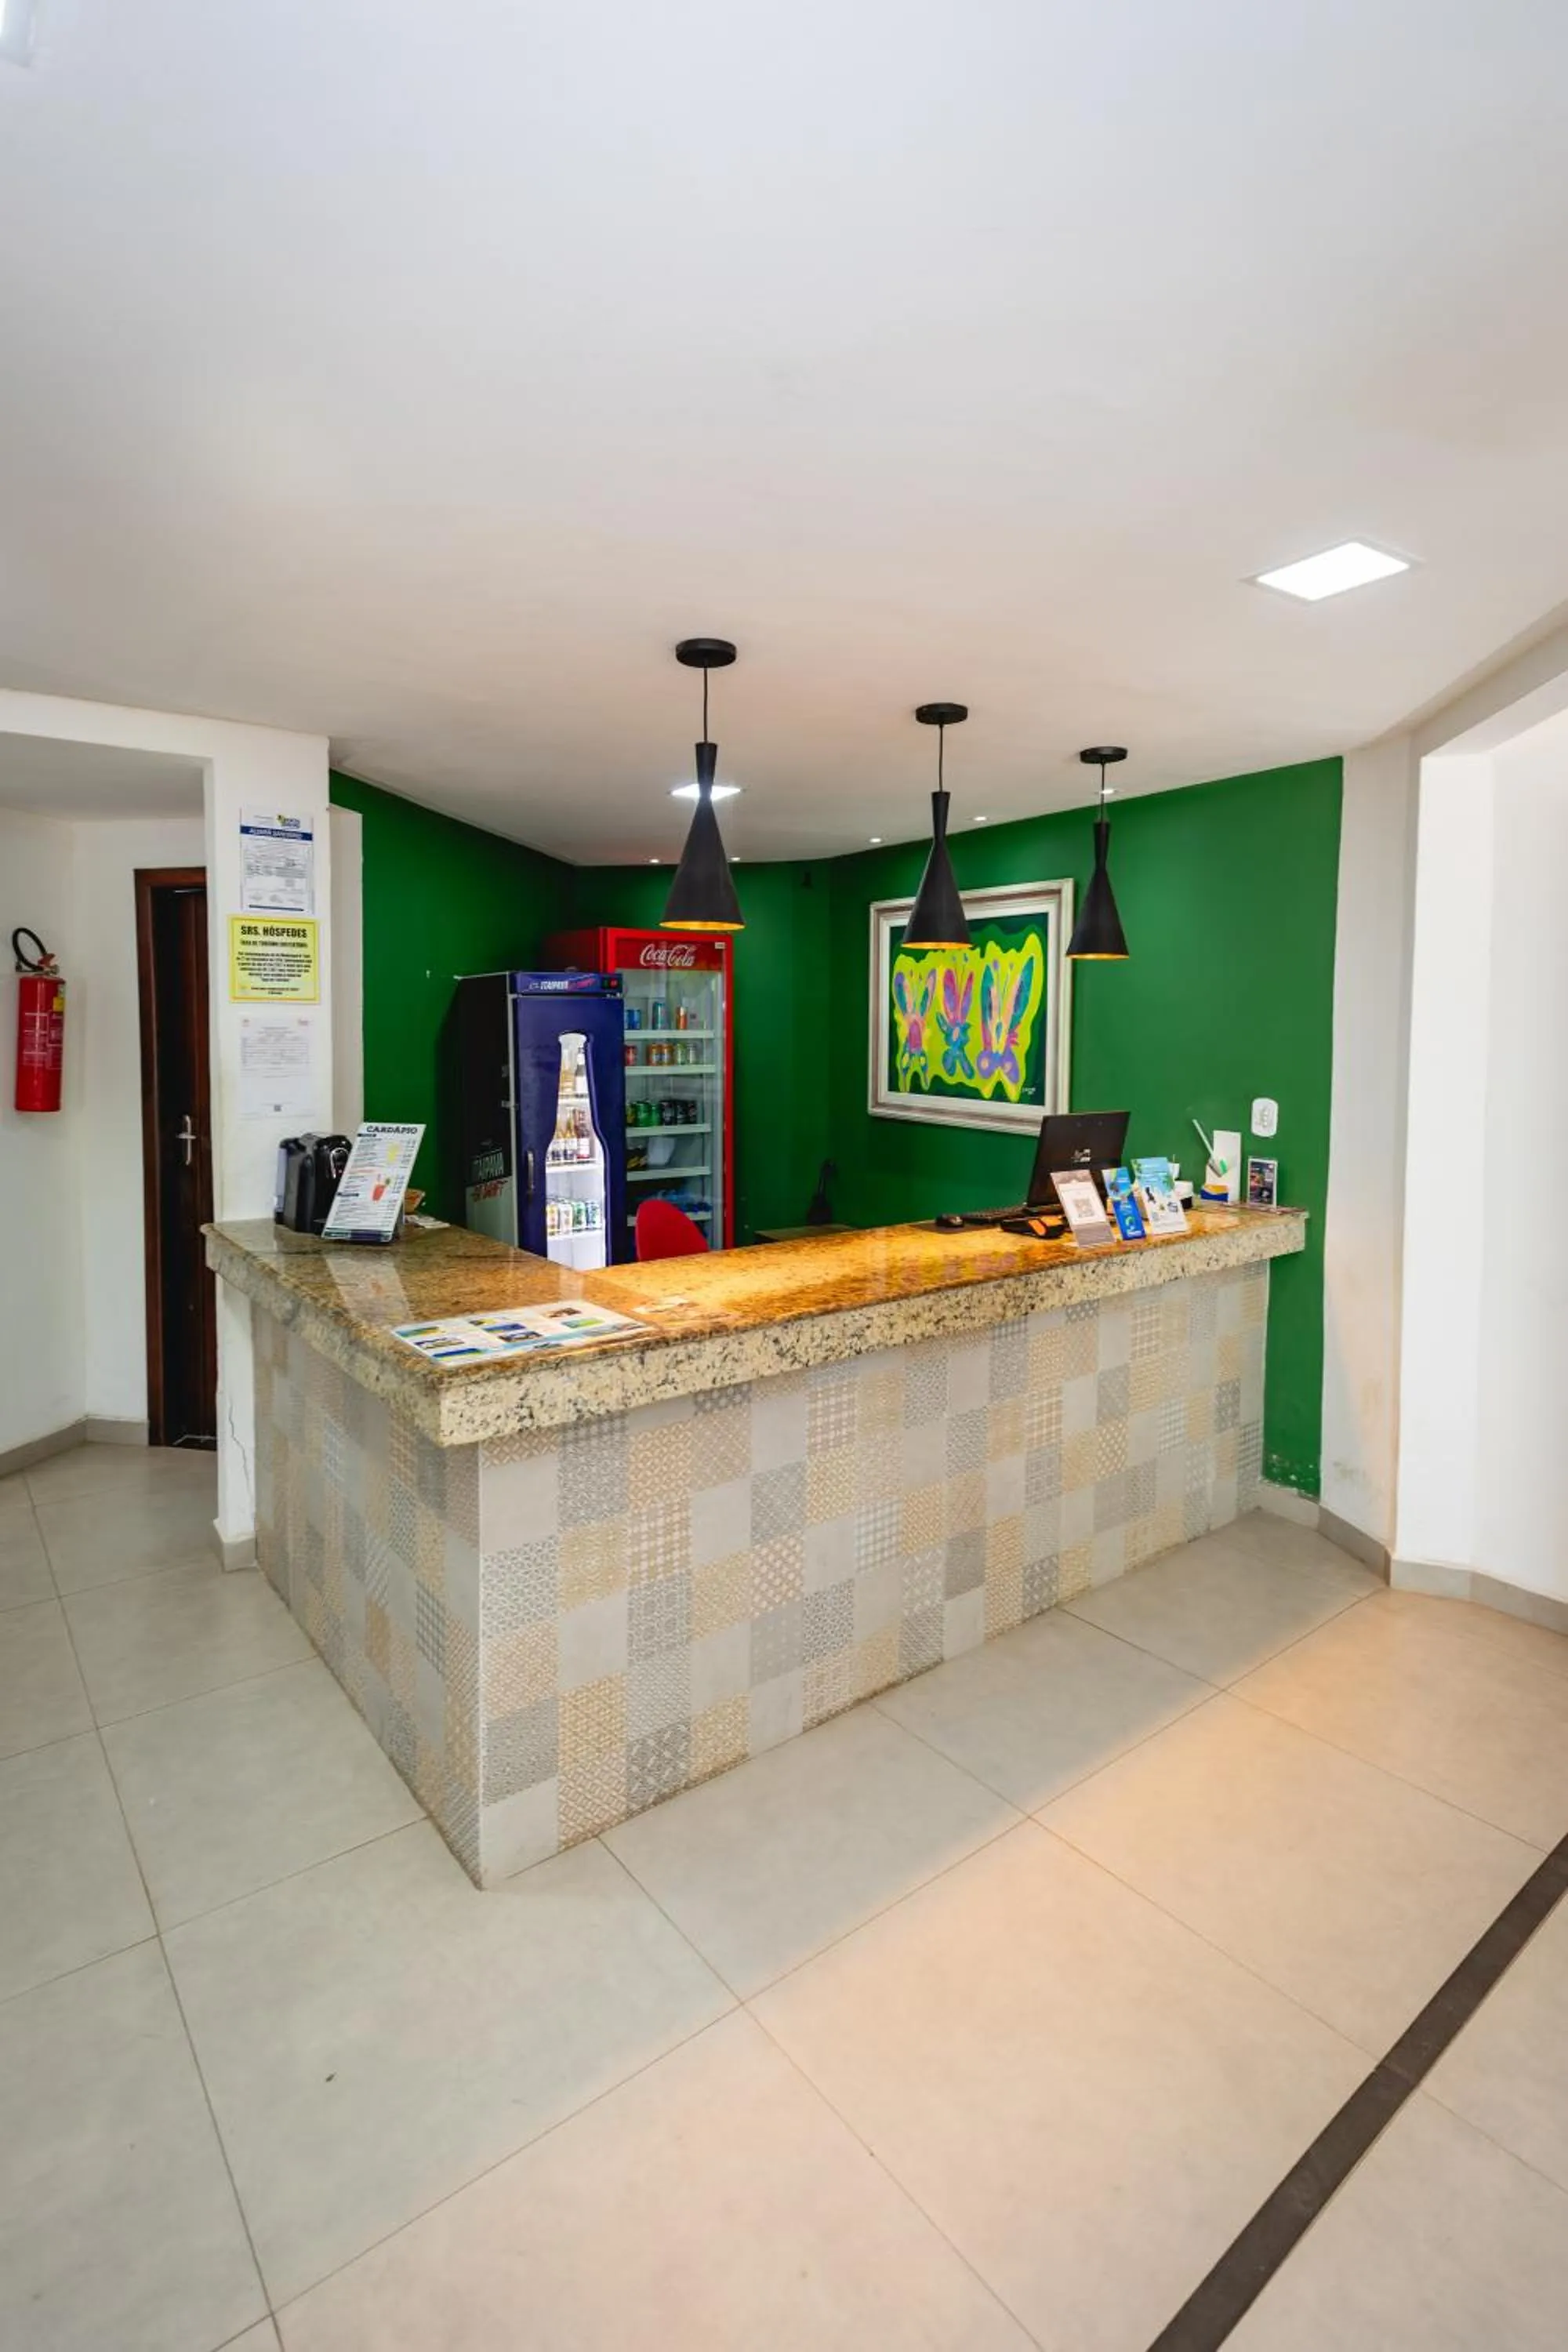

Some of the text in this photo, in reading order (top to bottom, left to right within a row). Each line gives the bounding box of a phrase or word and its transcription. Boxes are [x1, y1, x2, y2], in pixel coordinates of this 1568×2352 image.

[241, 925, 307, 938] SRS. HÓSPEDES
[366, 1125, 418, 1134] CARDÁPIO
